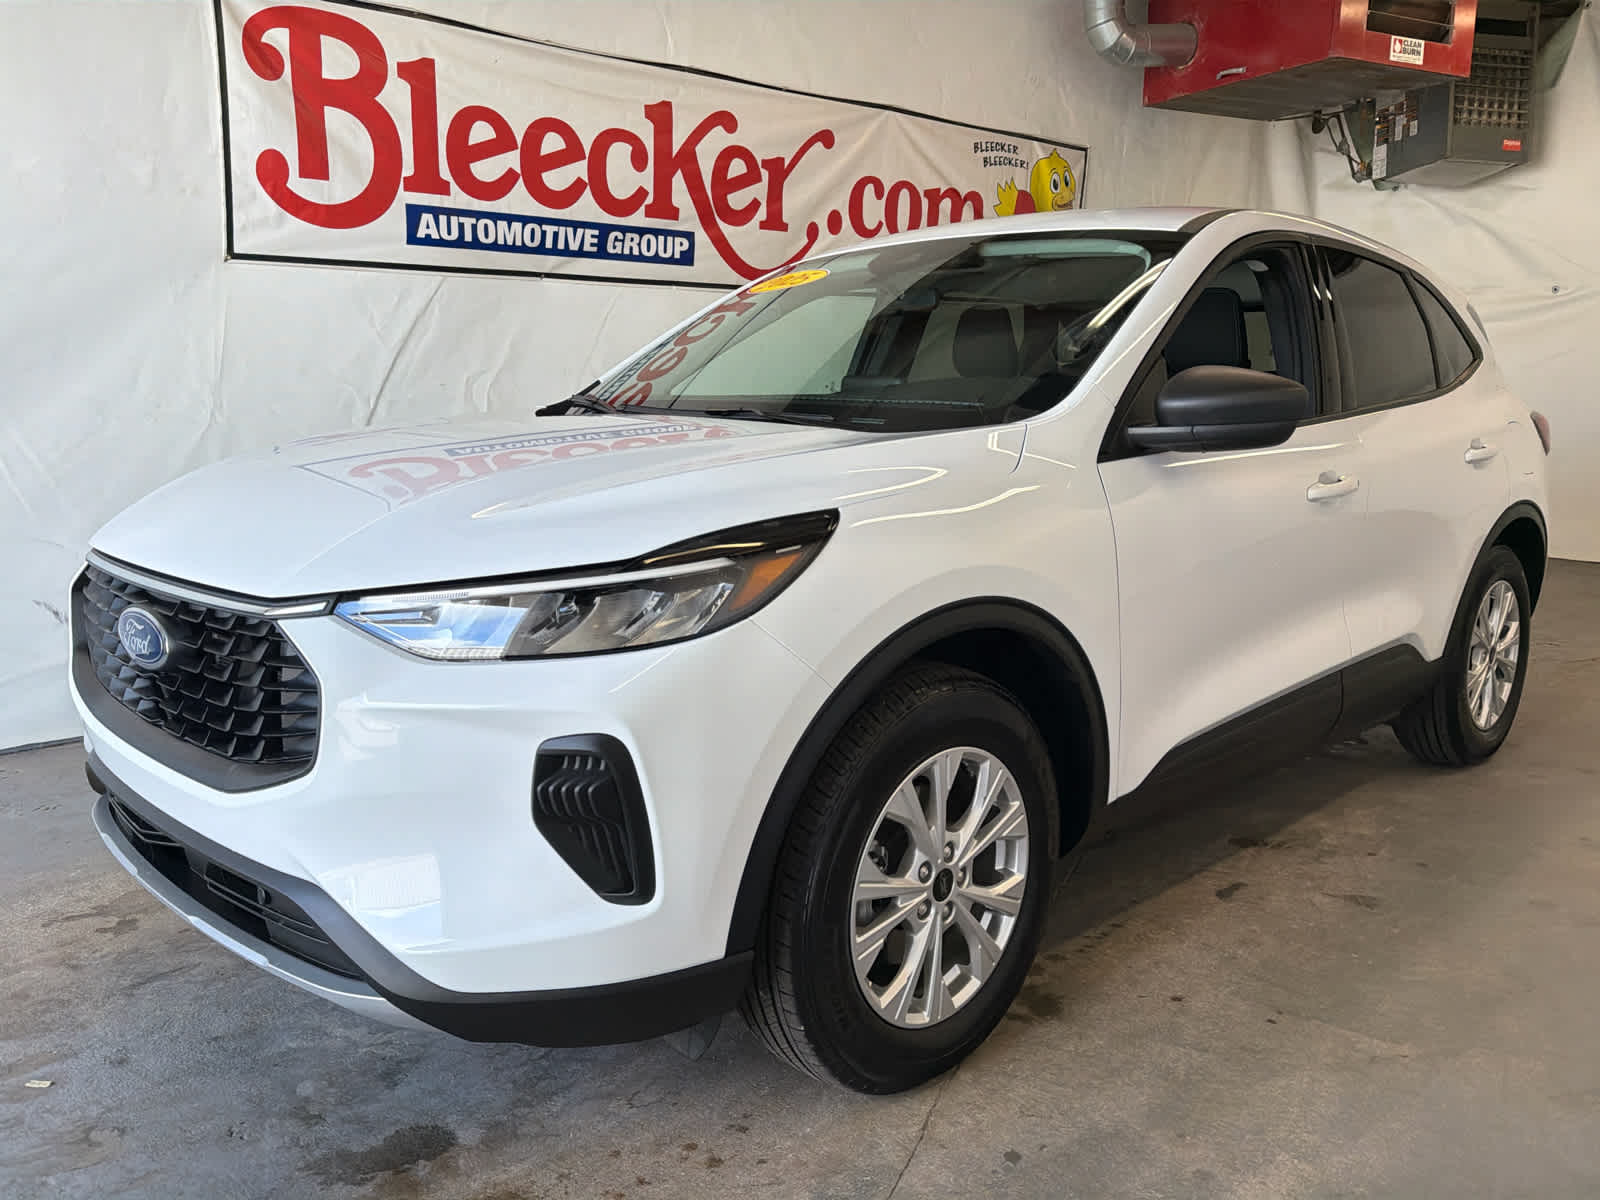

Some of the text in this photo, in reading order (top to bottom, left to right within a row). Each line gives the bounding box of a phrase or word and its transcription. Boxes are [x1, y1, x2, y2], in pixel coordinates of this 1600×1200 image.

[1403, 40, 1422, 48] CLEAN
[1402, 47, 1421, 56] BURN
[973, 141, 1019, 155] BLEECKER
[983, 155, 1029, 169] BLEECKER!
[416, 212, 690, 259] AUTOMOTIVE GROUP
[124, 618, 153, 655] Ford
